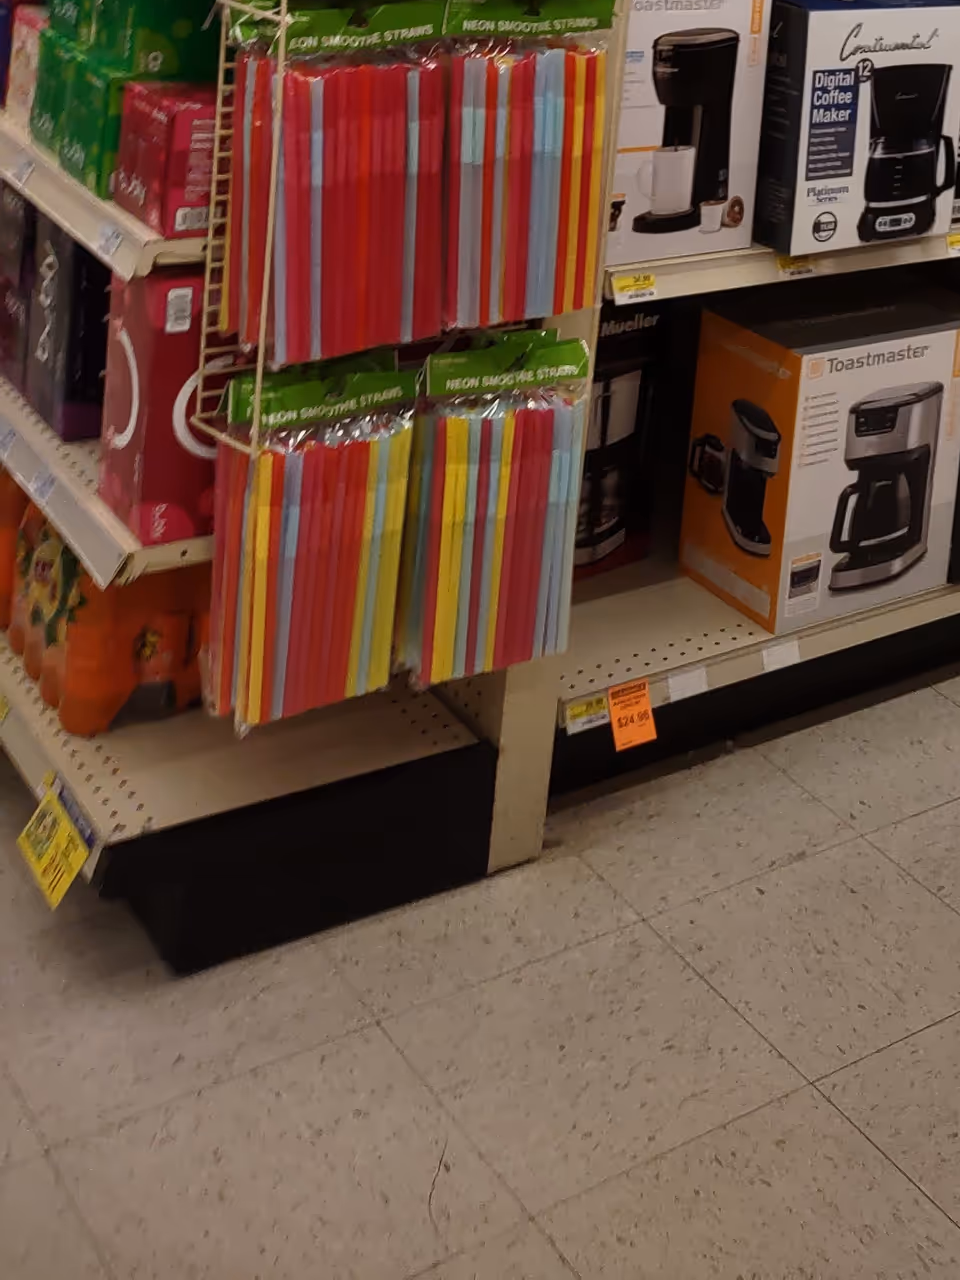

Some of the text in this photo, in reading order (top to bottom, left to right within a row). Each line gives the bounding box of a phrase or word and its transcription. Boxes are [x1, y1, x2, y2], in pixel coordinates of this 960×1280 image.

[462, 17, 599, 33] NEON SMOOTHIE STRAWS
[289, 24, 434, 50] EON SMOOTHIE STRAWS
[857, 60, 872, 77] 12
[814, 71, 855, 91] Digital
[813, 90, 853, 107] Coffee
[811, 107, 852, 124] Maker
[806, 185, 850, 199] Platinum
[600, 311, 660, 338] Mueller
[827, 344, 930, 375] Toastmaster
[446, 376, 480, 391] NEON
